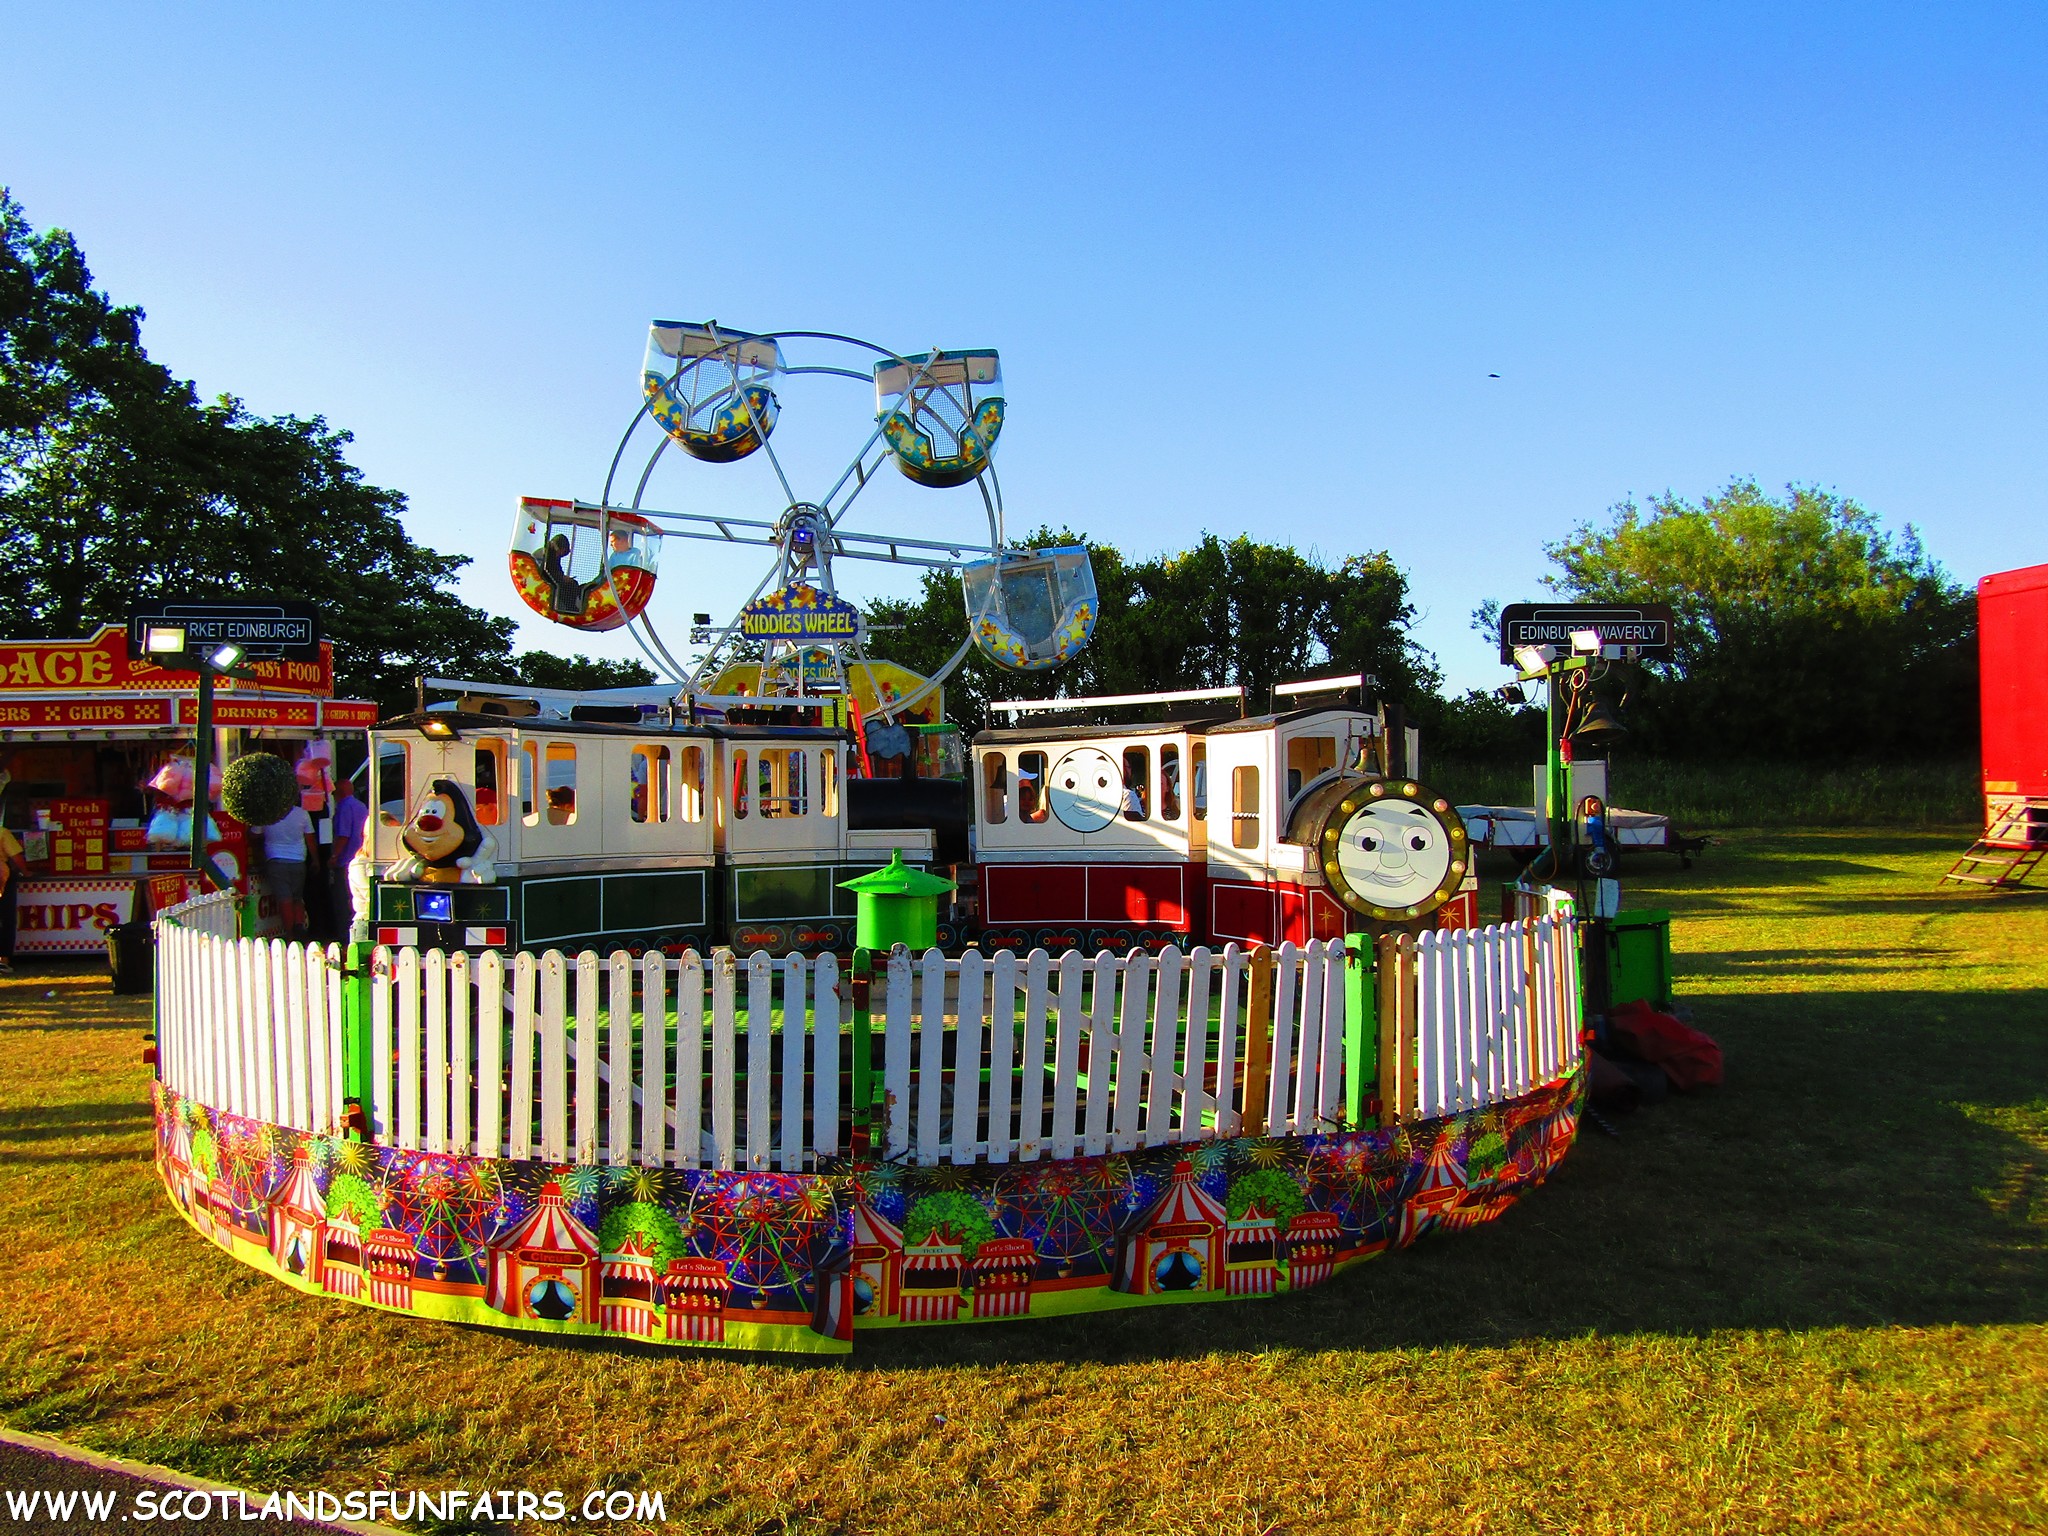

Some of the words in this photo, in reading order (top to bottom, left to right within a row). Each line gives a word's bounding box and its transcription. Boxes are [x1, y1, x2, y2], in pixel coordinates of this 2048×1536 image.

[190, 622, 224, 637] RKET
[228, 623, 305, 638] EDINBURGH
[745, 613, 802, 634] KIDDIES
[804, 612, 854, 633] WHEEL
[1599, 625, 1657, 640] WAVERLY
[0, 651, 113, 684] ACE
[288, 661, 321, 684] FOOD
[69, 706, 125, 720] CHIPS
[217, 707, 278, 719] DRINKS
[330, 710, 349, 720] CHIPS
[357, 711, 371, 720] DIPS
[60, 803, 99, 813] Fresh
[69, 819, 89, 827] Hot
[77, 828, 103, 837] Nuts
[157, 878, 181, 894] FRESH
[17, 903, 120, 931] HIPS
[695, 1264, 717, 1272] Shoot
